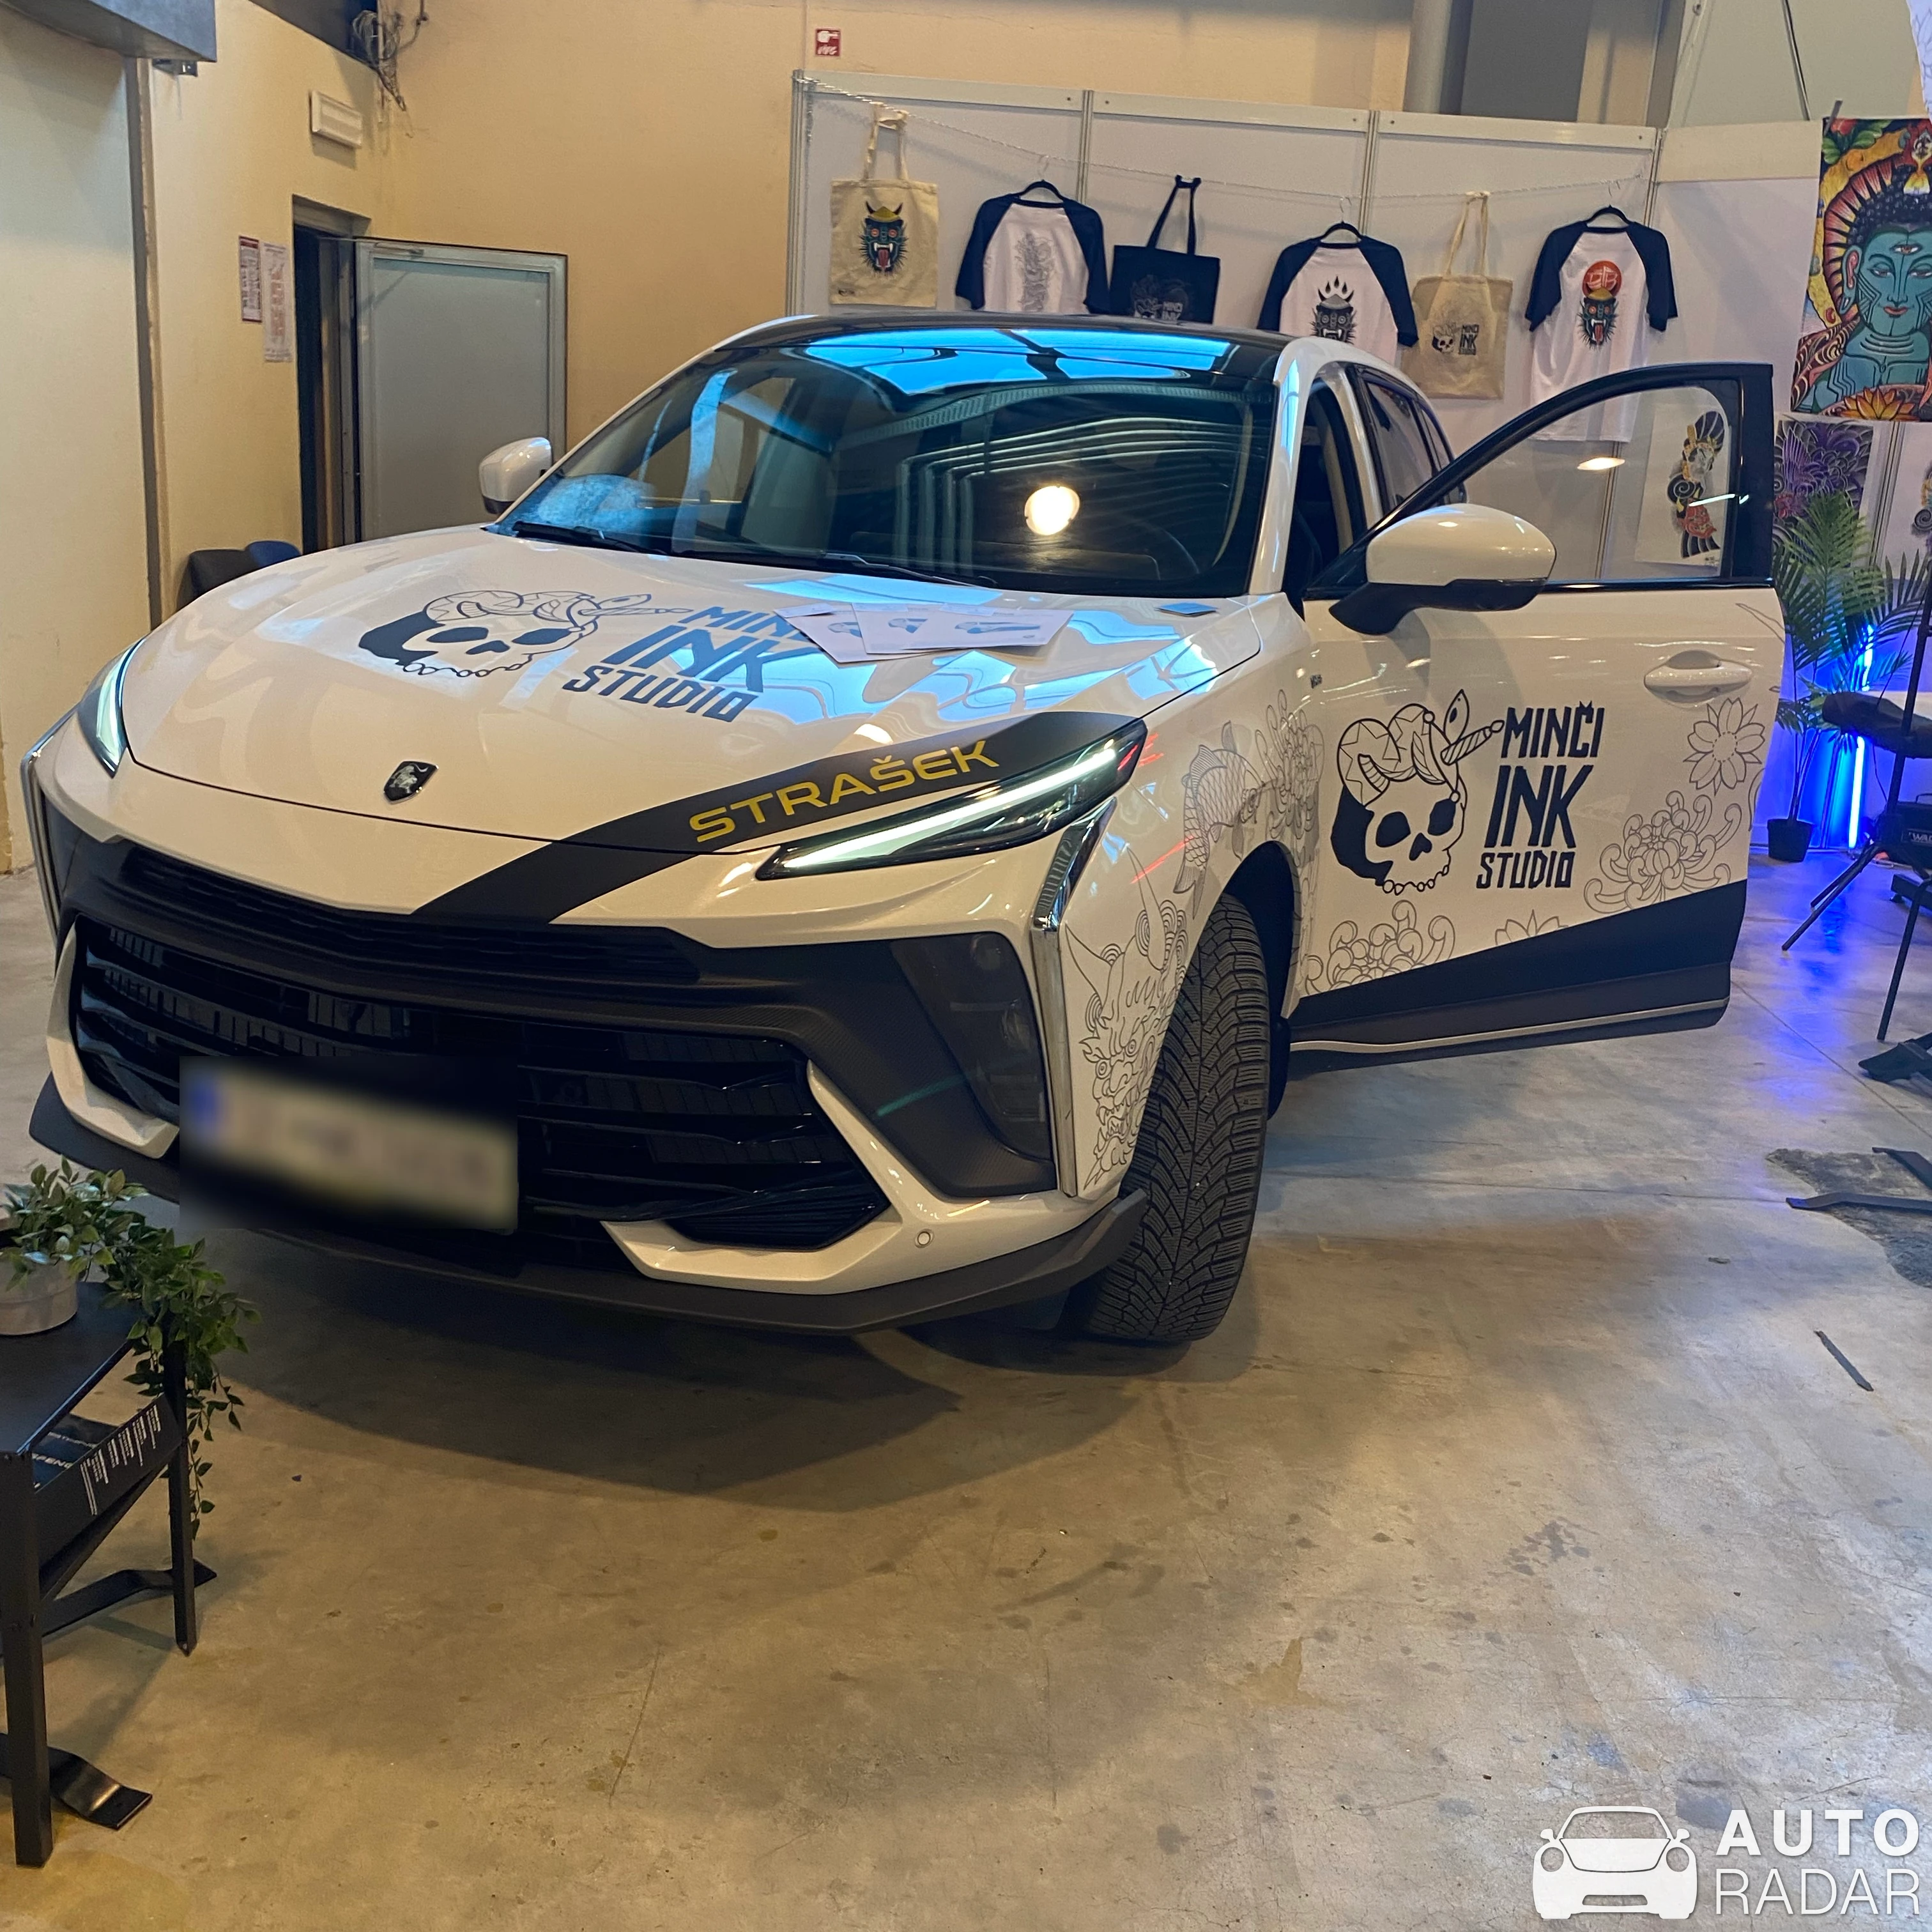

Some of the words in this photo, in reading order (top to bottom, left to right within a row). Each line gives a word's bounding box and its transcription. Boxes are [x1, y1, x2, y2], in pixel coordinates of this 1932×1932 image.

[1459, 334, 1478, 349] INK
[678, 606, 810, 643] MIN
[600, 625, 823, 693] INK
[562, 665, 760, 723] STUDIO
[1501, 700, 1605, 758] MINČI
[689, 740, 999, 843] STRAŠEK
[1484, 765, 1594, 848] INK
[1476, 850, 1575, 889] STUDIO
